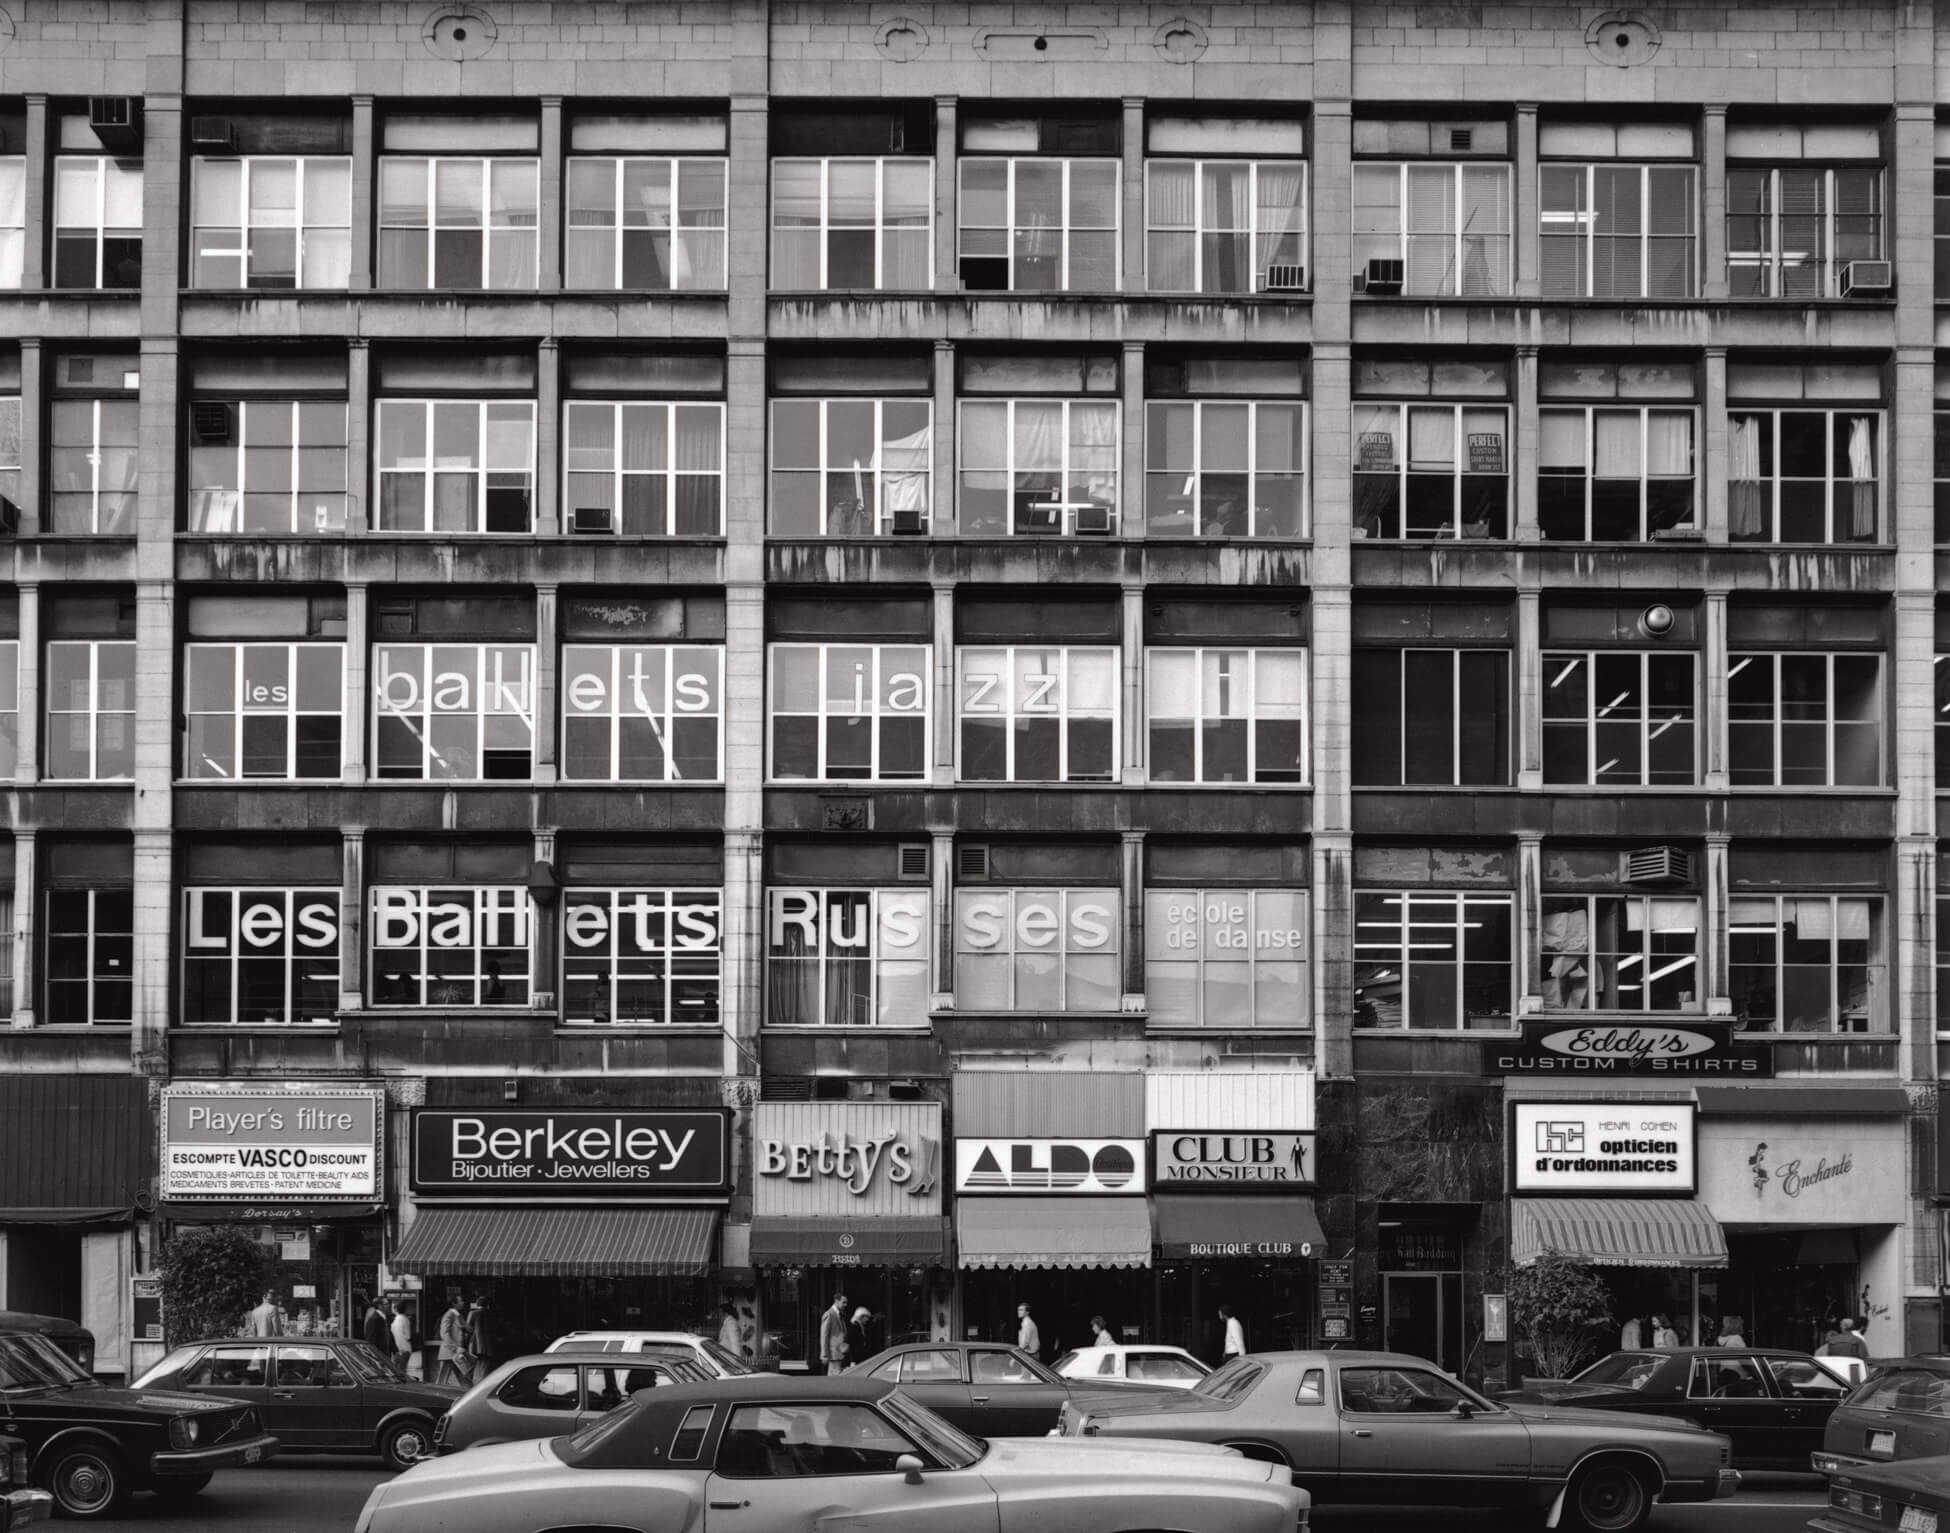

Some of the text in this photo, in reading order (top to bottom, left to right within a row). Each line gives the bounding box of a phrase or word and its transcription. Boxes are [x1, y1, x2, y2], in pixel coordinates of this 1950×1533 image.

[1469, 435, 1501, 447] PERFECT
[244, 650, 1058, 726] les ballets jazz
[188, 888, 1112, 951] Les Ballets Russes
[1166, 925, 1302, 950] de danse
[1568, 1029, 1689, 1067] Eddy's
[1498, 1057, 1758, 1071] CUSTOM SHIRTS
[188, 1107, 353, 1135] Player's filtre
[1599, 1121, 1678, 1132] HENRI COHEN
[451, 1118, 696, 1171] Berkeley
[1172, 1136, 1275, 1163] CLUB
[1600, 1139, 1678, 1155] opticien
[173, 1149, 368, 1168] ESCOMPTE VASCO DISCOUNT
[964, 1144, 1135, 1188] ALDO
[1536, 1157, 1678, 1173] d'ordonnances
[268, 1171, 279, 1180] DE
[351, 1171, 369, 1180] AIDS
[451, 1160, 650, 1181] Bijoutier Jewellers
[1167, 1165, 1288, 1181] MONSIEUR
[1775, 1153, 1853, 1198] Enchanté
[273, 1180, 303, 1189] PATENT
[305, 1180, 342, 1190] MEDICINE
[242, 1208, 303, 1219] Dorsay's
[1190, 1242, 1292, 1255] BOUTIQUE CLUB
